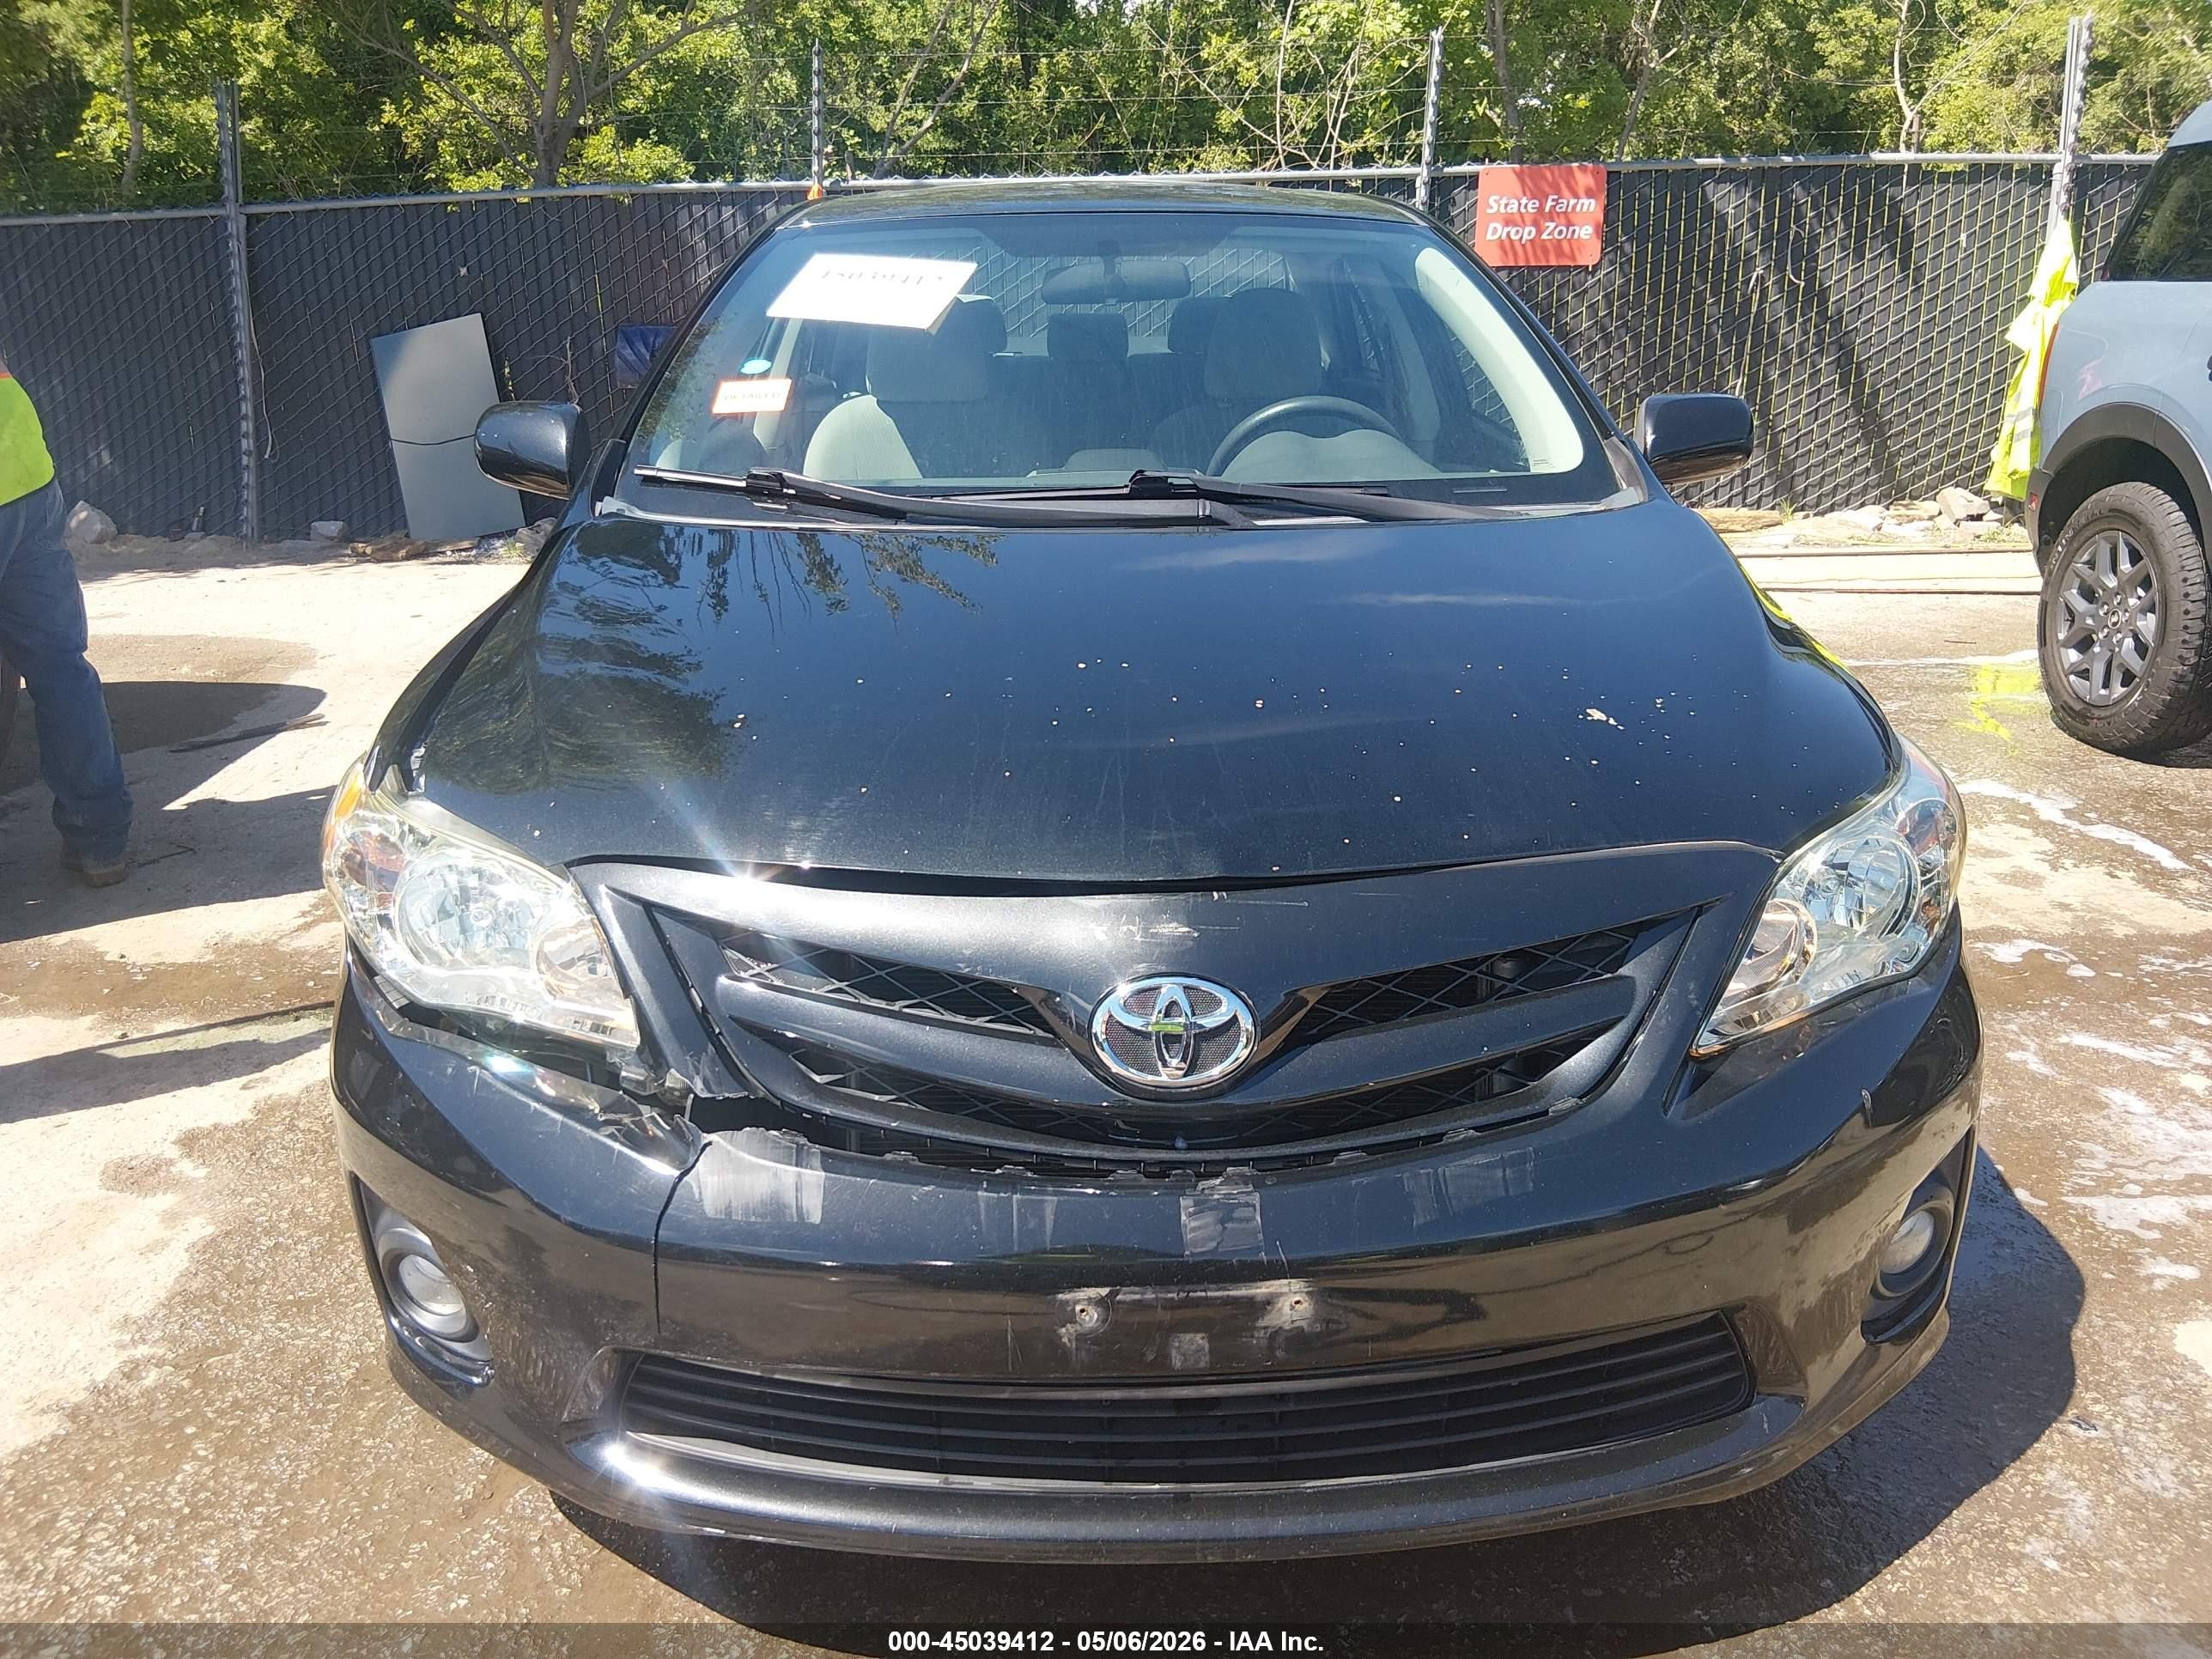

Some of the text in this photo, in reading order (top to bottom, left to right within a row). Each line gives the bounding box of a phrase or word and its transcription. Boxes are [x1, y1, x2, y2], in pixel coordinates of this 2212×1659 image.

[1486, 194, 1596, 214] State Farm
[1486, 222, 1594, 245] Drop Zone
